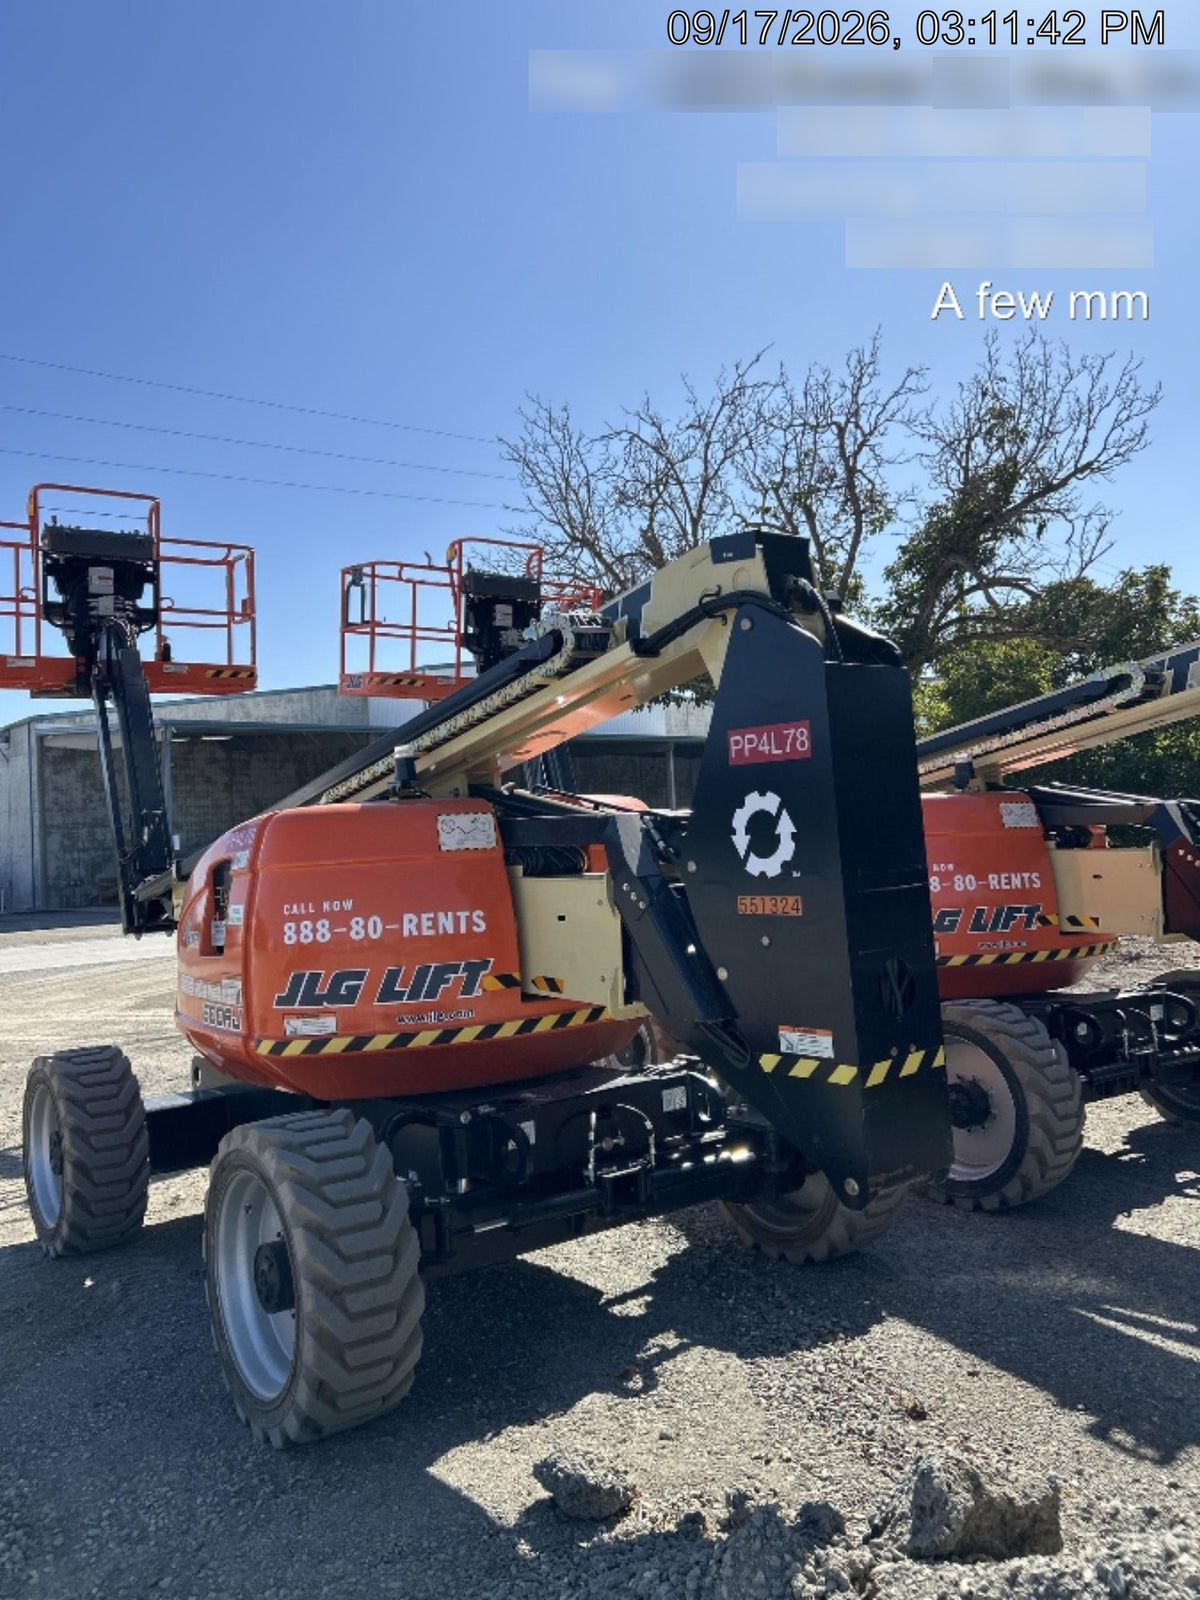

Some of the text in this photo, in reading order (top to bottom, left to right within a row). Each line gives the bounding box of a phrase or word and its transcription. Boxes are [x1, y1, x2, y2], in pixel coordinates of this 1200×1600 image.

[730, 728, 809, 758] PP4L78
[929, 872, 1041, 893] 8-80-RENTS
[284, 899, 353, 915] CALL NOW
[738, 896, 801, 915] 551324
[967, 903, 1043, 934] LIFT
[283, 910, 487, 945] 888-80-RENTS
[272, 968, 371, 1009] JLG
[373, 957, 495, 1005] LIFT
